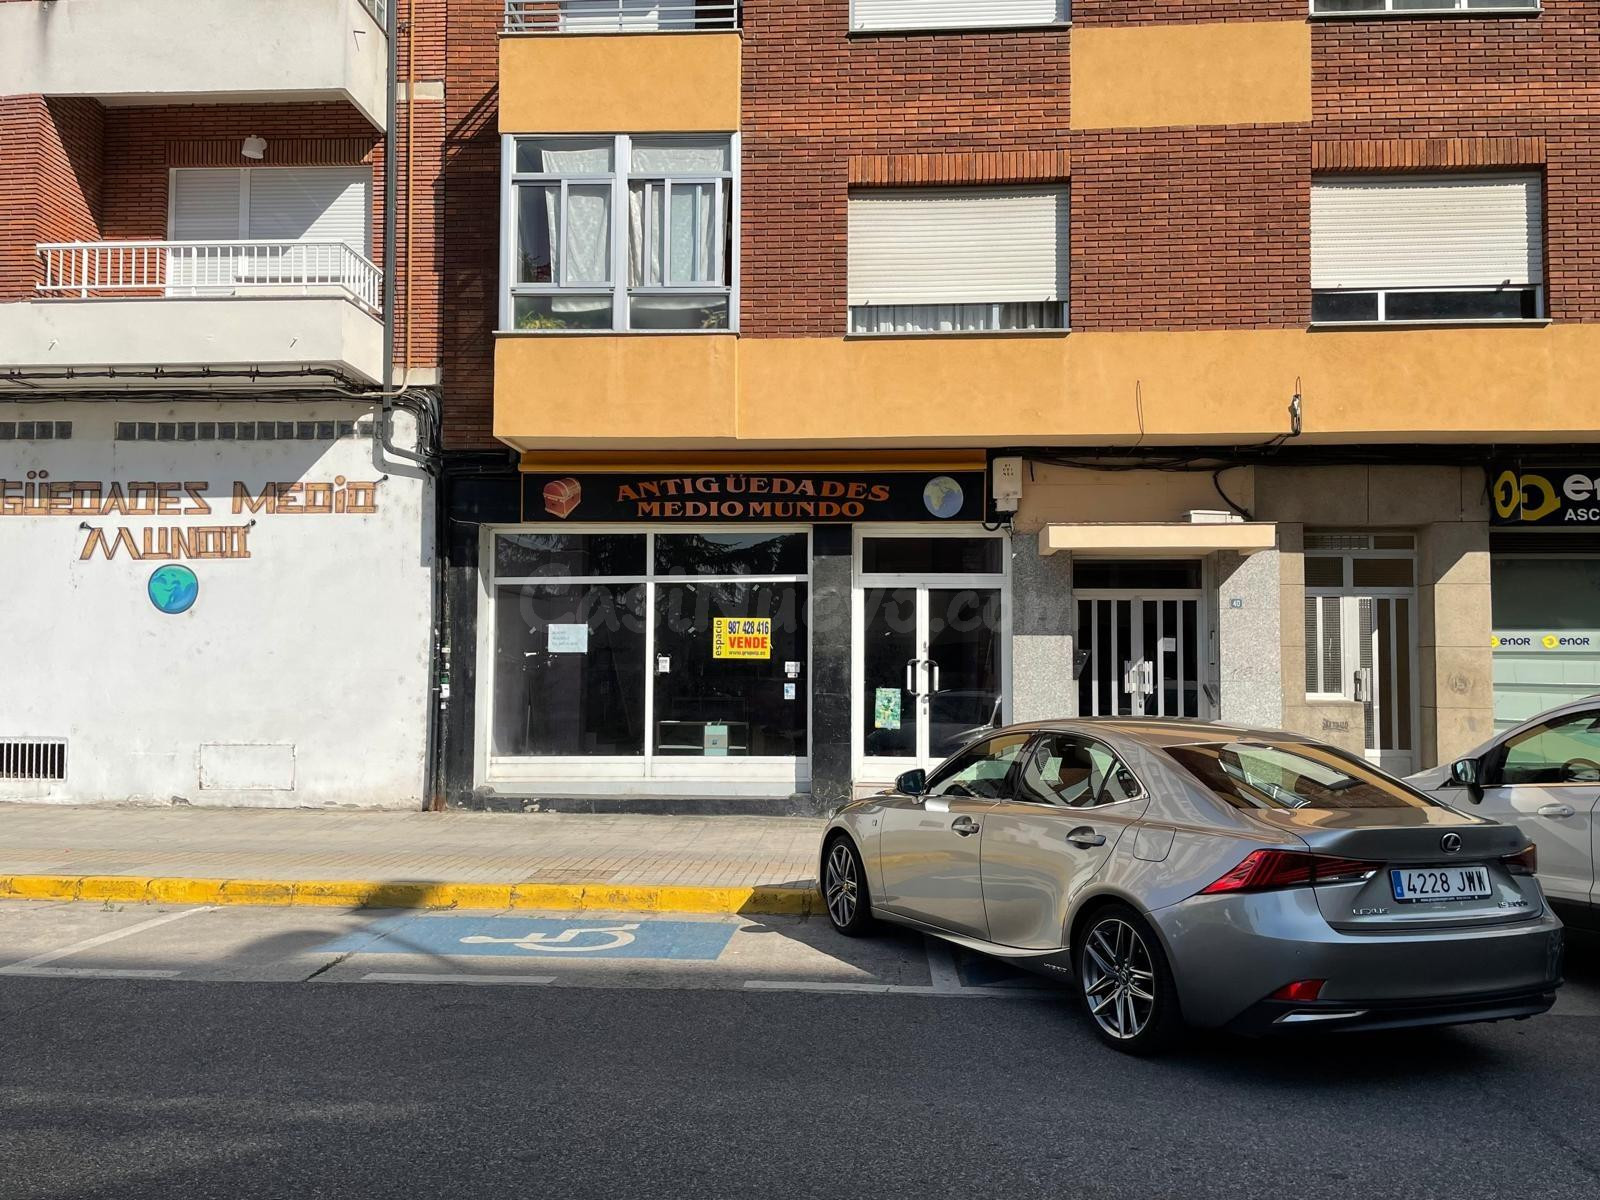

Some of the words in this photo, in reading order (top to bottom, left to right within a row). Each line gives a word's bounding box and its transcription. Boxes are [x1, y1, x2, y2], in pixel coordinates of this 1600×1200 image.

[1563, 474, 1600, 501] e
[637, 501, 743, 517] MEDIO
[749, 501, 864, 517] MUNDO
[728, 620, 741, 635] 987
[743, 620, 755, 635] 428
[756, 620, 769, 635] 416
[715, 619, 724, 656] espacio
[728, 636, 768, 649] VENDE
[1407, 872, 1451, 895] 4228
